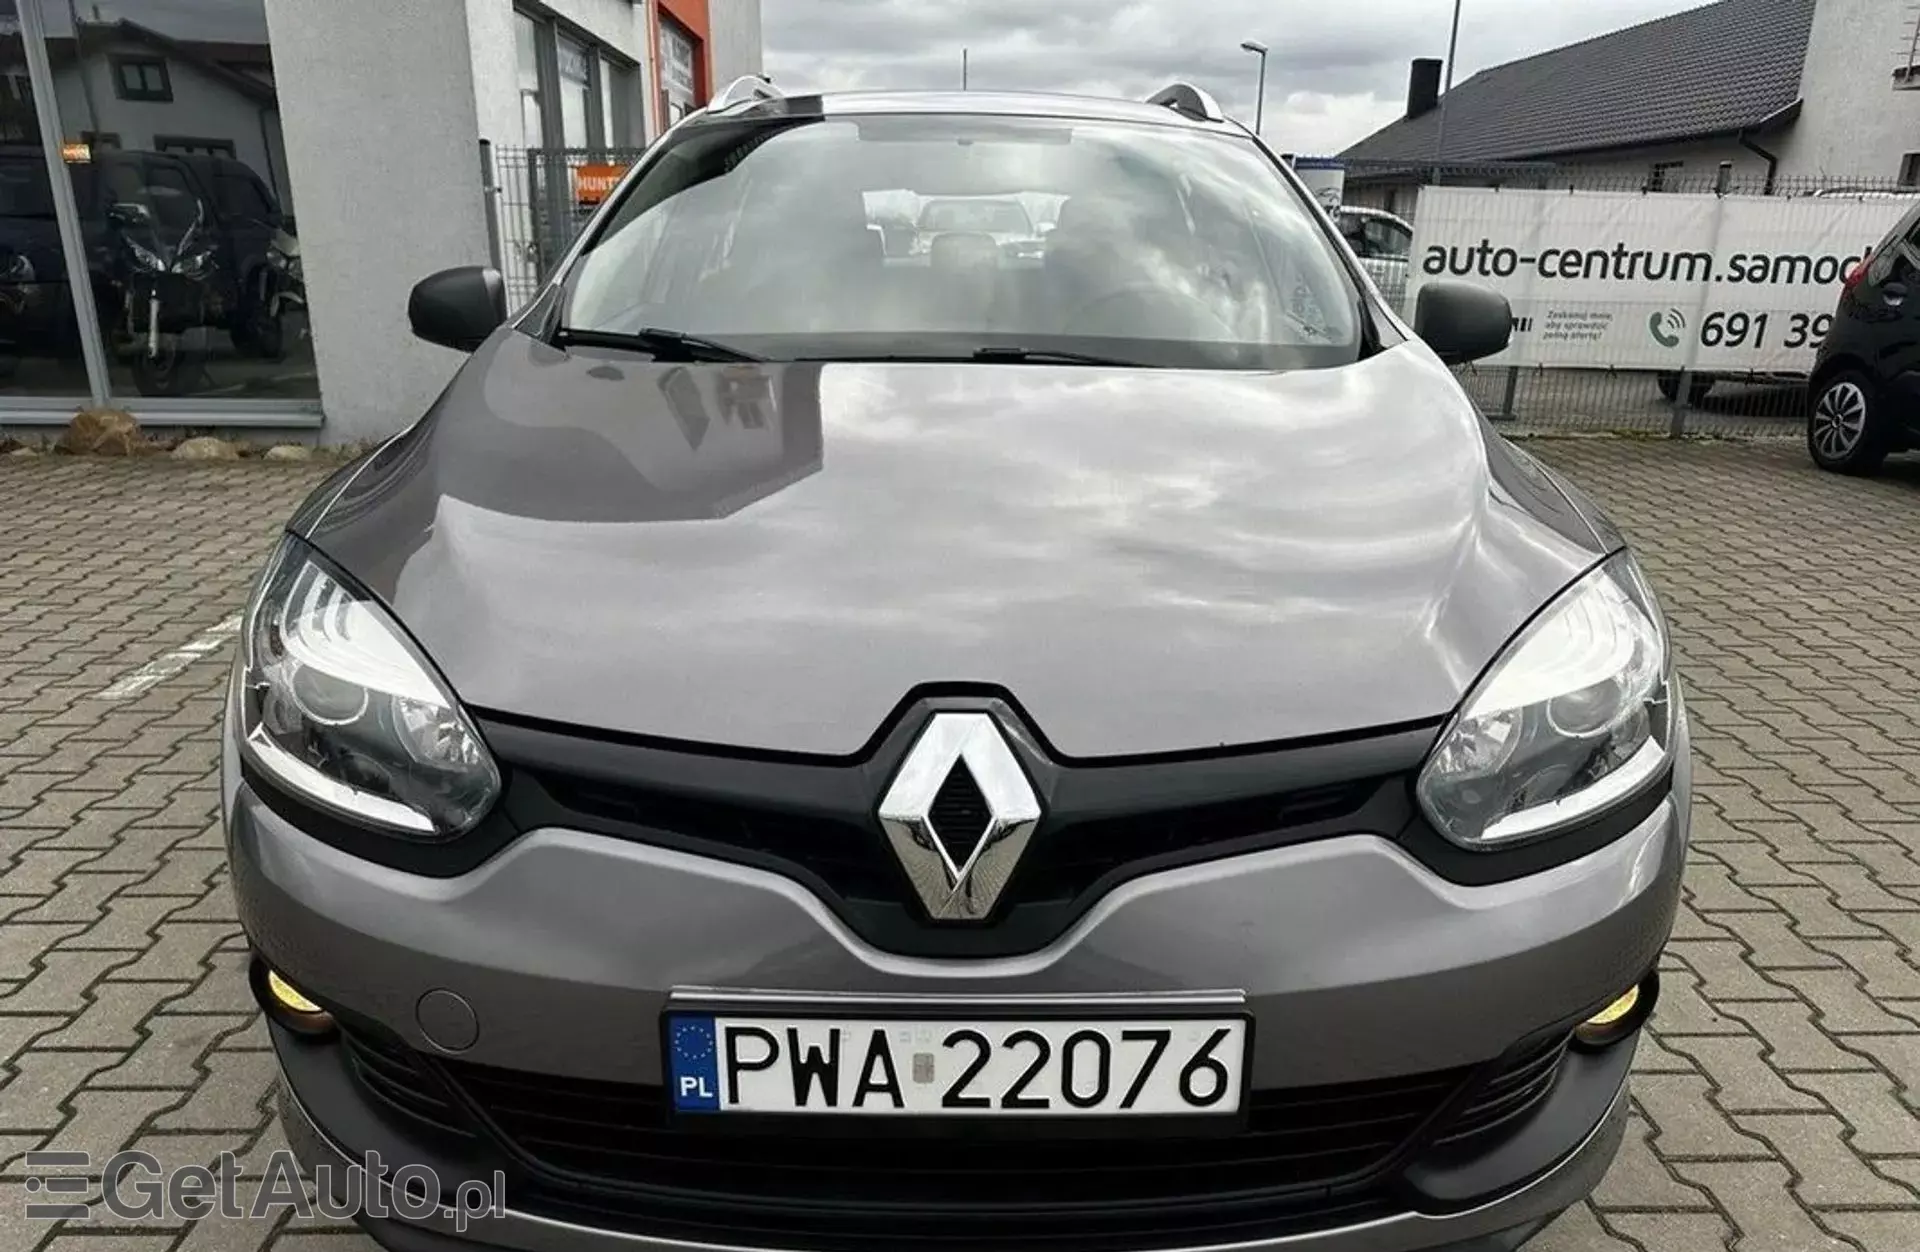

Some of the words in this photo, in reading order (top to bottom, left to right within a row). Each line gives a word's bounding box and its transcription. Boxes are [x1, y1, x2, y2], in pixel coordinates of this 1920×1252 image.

[578, 176, 620, 191] HUNT
[1700, 312, 1769, 349] 691
[1783, 313, 1834, 349] 39
[725, 1026, 905, 1108] PWA
[941, 1028, 1232, 1110] 22076
[680, 1076, 714, 1098] PL
